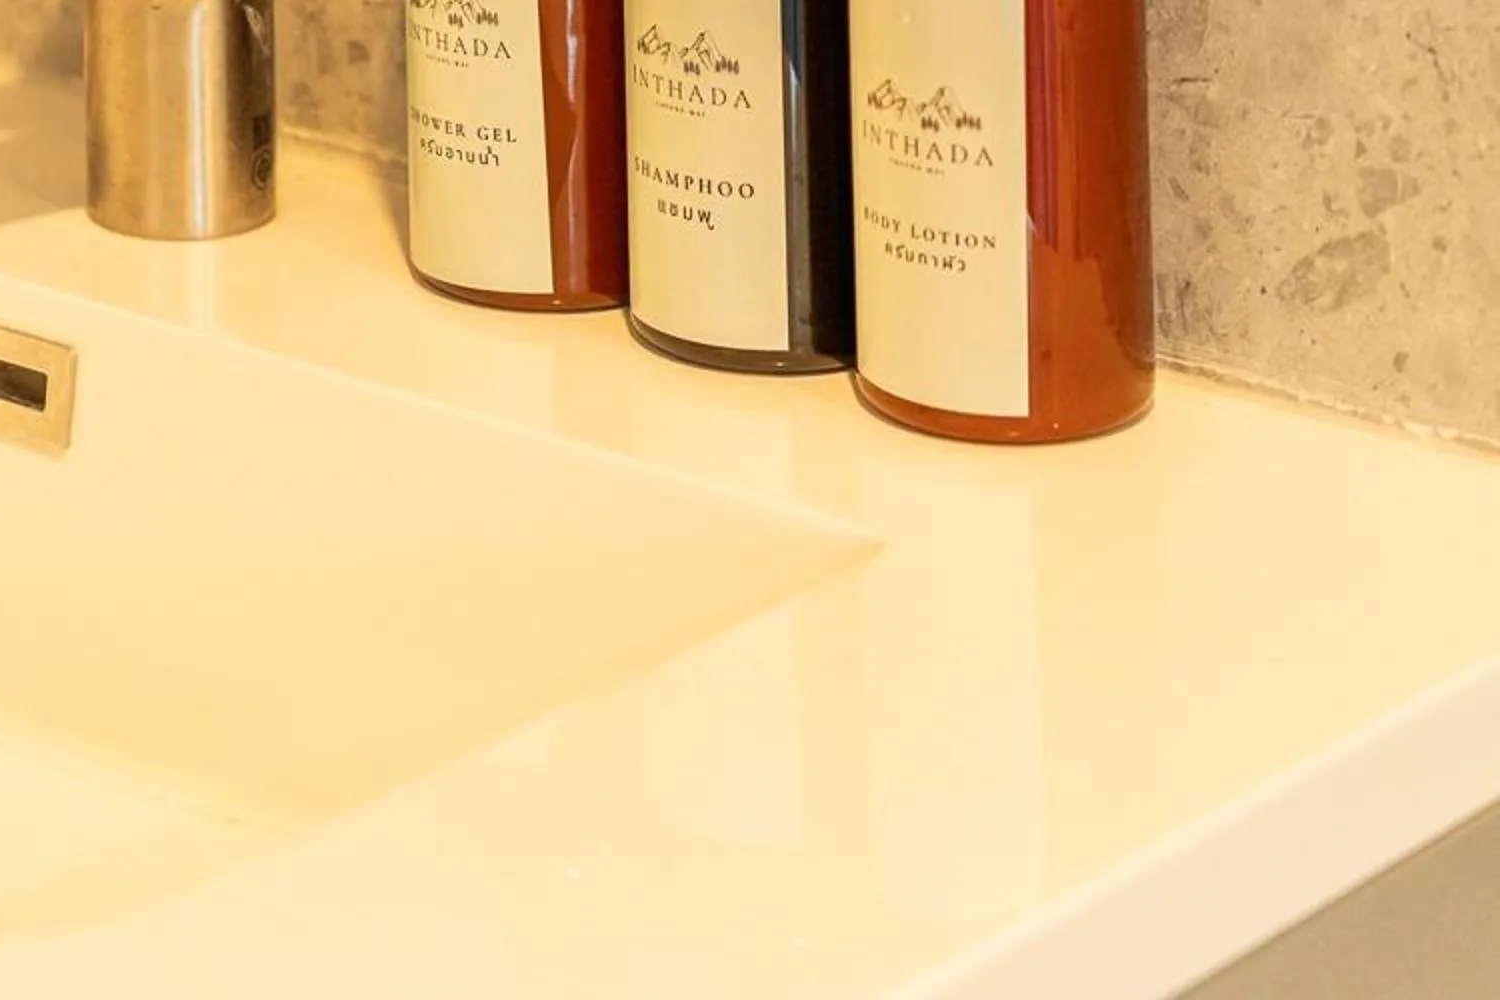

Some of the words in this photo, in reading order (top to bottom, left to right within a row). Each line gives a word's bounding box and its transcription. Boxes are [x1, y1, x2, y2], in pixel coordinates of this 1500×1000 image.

[632, 64, 752, 110] INTHADA
[476, 124, 518, 144] GEL
[863, 119, 994, 168] INTHADA
[634, 155, 755, 200] SHAMPHOO
[910, 223, 998, 250] LOTION
